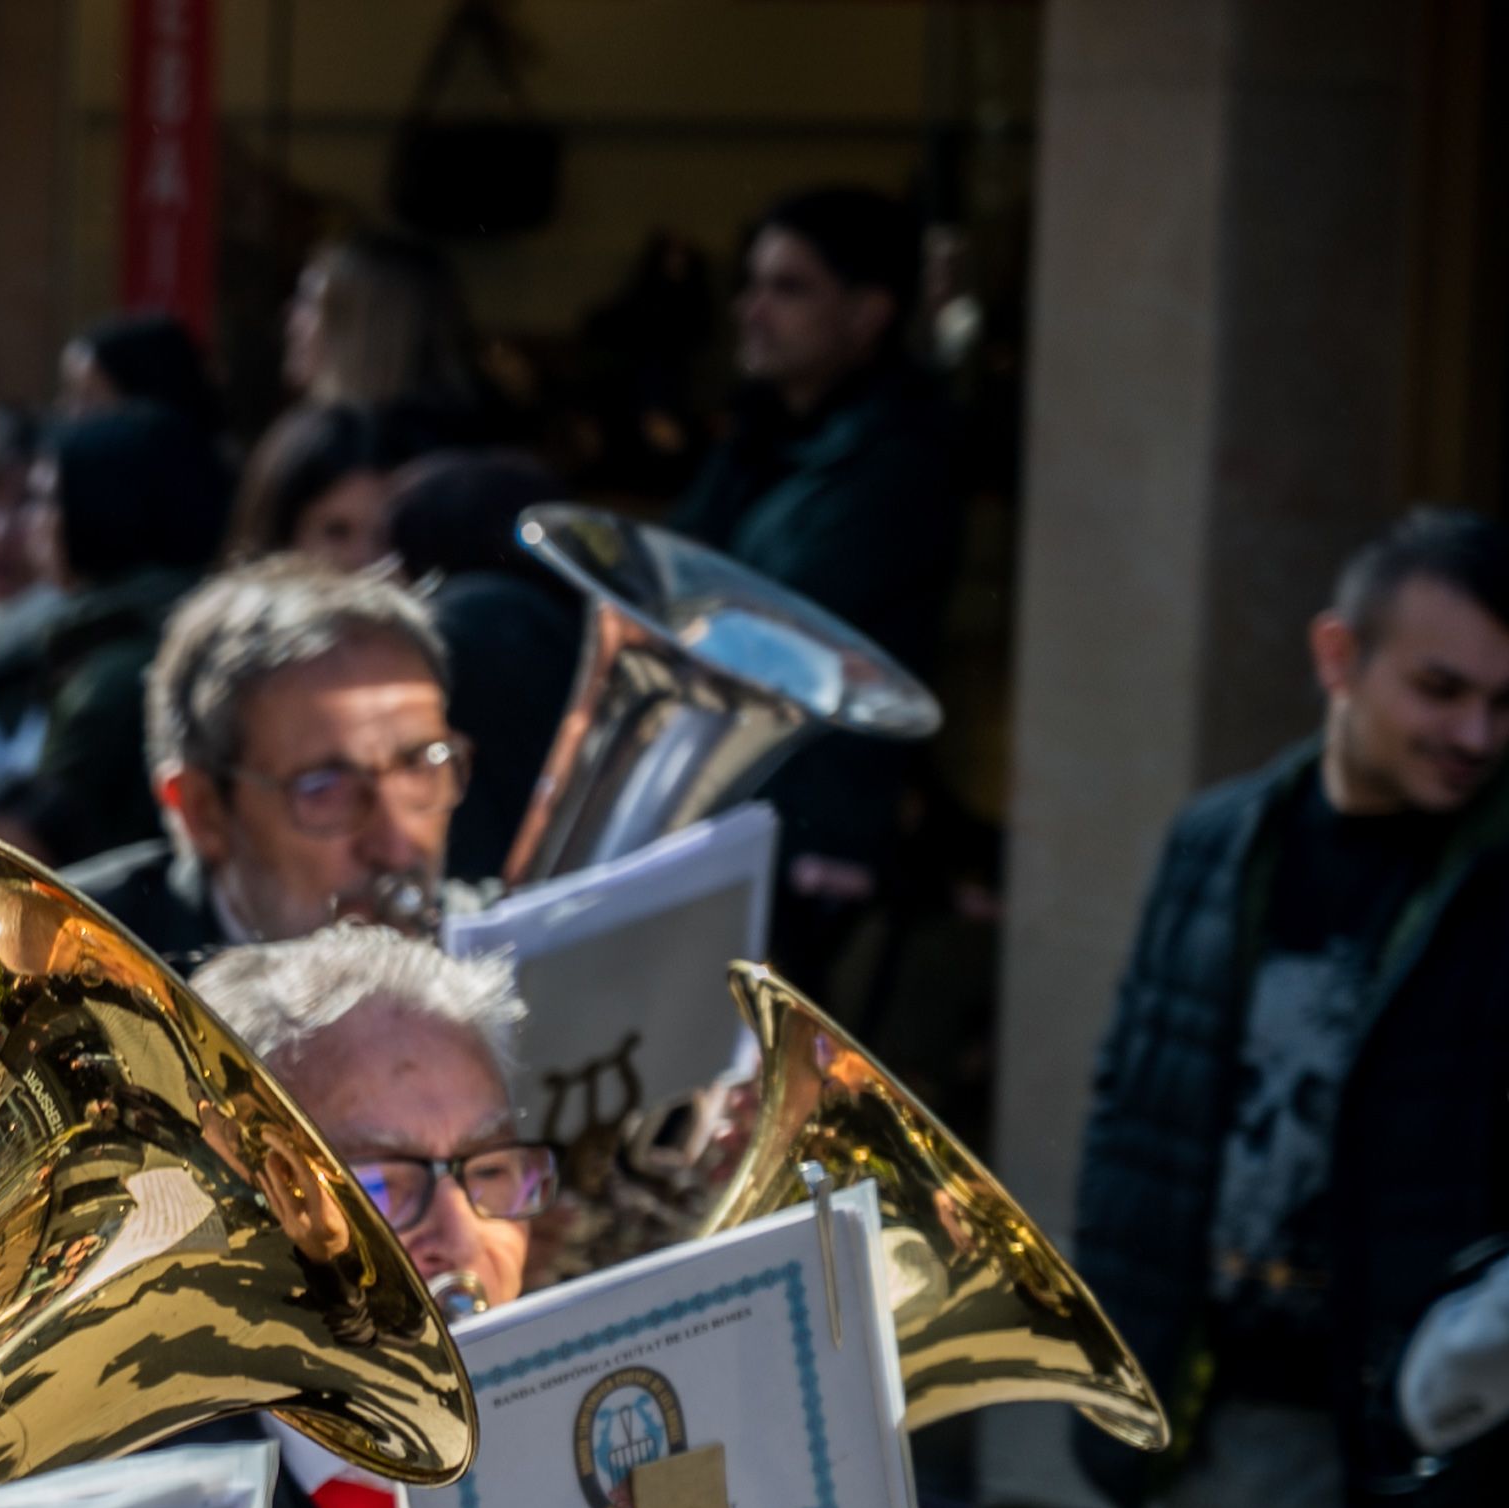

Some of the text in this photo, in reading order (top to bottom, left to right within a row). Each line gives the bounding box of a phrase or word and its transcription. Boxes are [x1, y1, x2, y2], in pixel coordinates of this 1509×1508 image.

[492, 1384, 536, 1408] BANDA
[614, 1339, 661, 1368] CIUTAT
[664, 1333, 683, 1349] DE
[686, 1323, 709, 1342] LES
[712, 1306, 753, 1334] ROSES
